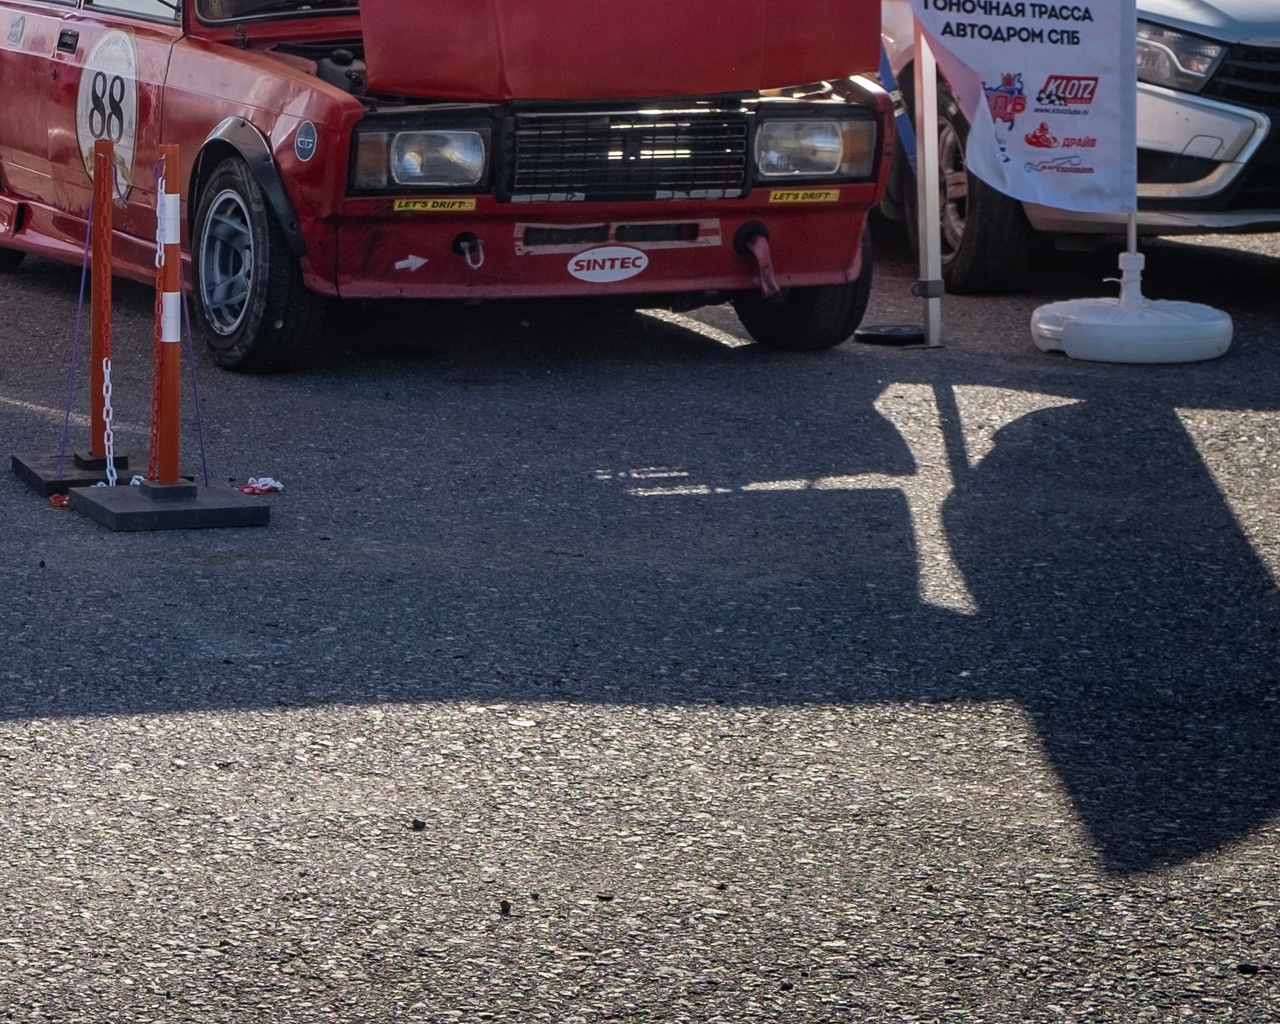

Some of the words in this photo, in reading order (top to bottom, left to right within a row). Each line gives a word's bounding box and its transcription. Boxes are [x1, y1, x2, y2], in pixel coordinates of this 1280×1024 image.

[1030, 2, 1094, 23] ТРАССА
[940, 21, 1044, 45] АВТОДРОМ
[1047, 28, 1081, 46] СПБ
[1045, 78, 1096, 99] KLOTZ
[89, 71, 126, 145] 88
[1062, 136, 1097, 149] ДРАЙВ
[397, 200, 429, 209] LET'S
[773, 192, 800, 201] LET'S
[572, 255, 643, 272] SINTEC
